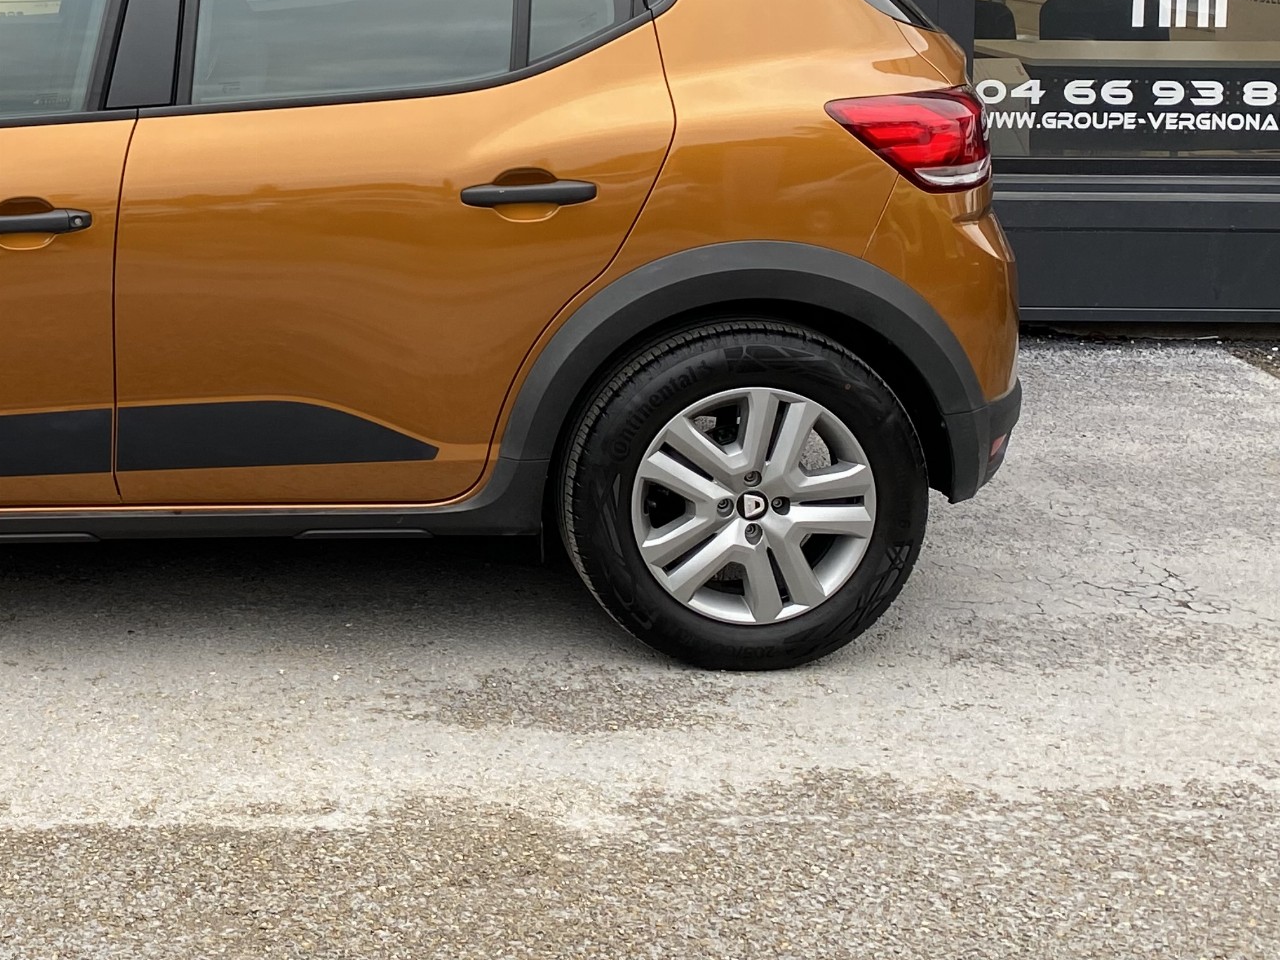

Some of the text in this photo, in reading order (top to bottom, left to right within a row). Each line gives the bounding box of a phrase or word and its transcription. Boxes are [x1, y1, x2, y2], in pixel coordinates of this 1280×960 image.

[975, 79, 1278, 107] 04 66 93 8
